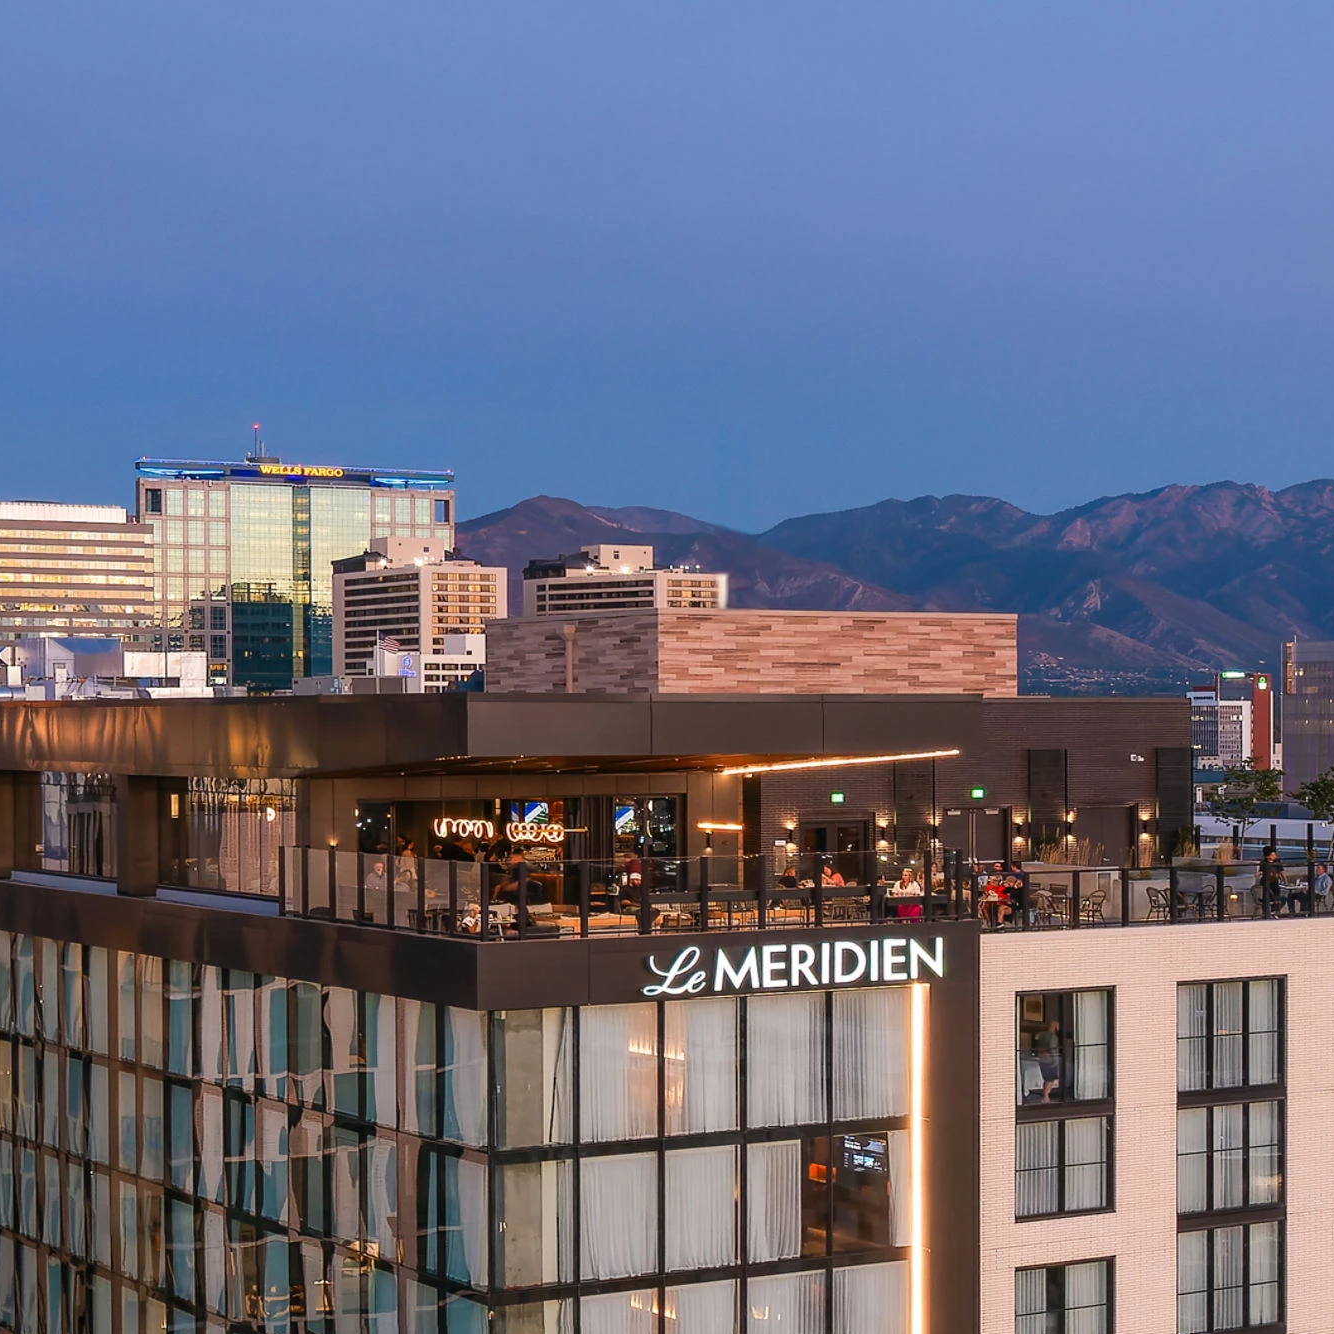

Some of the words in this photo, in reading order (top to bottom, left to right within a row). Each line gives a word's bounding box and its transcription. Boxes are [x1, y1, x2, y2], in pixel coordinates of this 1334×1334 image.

[260, 465, 302, 475] WELLS
[303, 467, 344, 477] FARGO
[642, 946, 707, 997] Le
[714, 936, 944, 992] MERIDIEN
